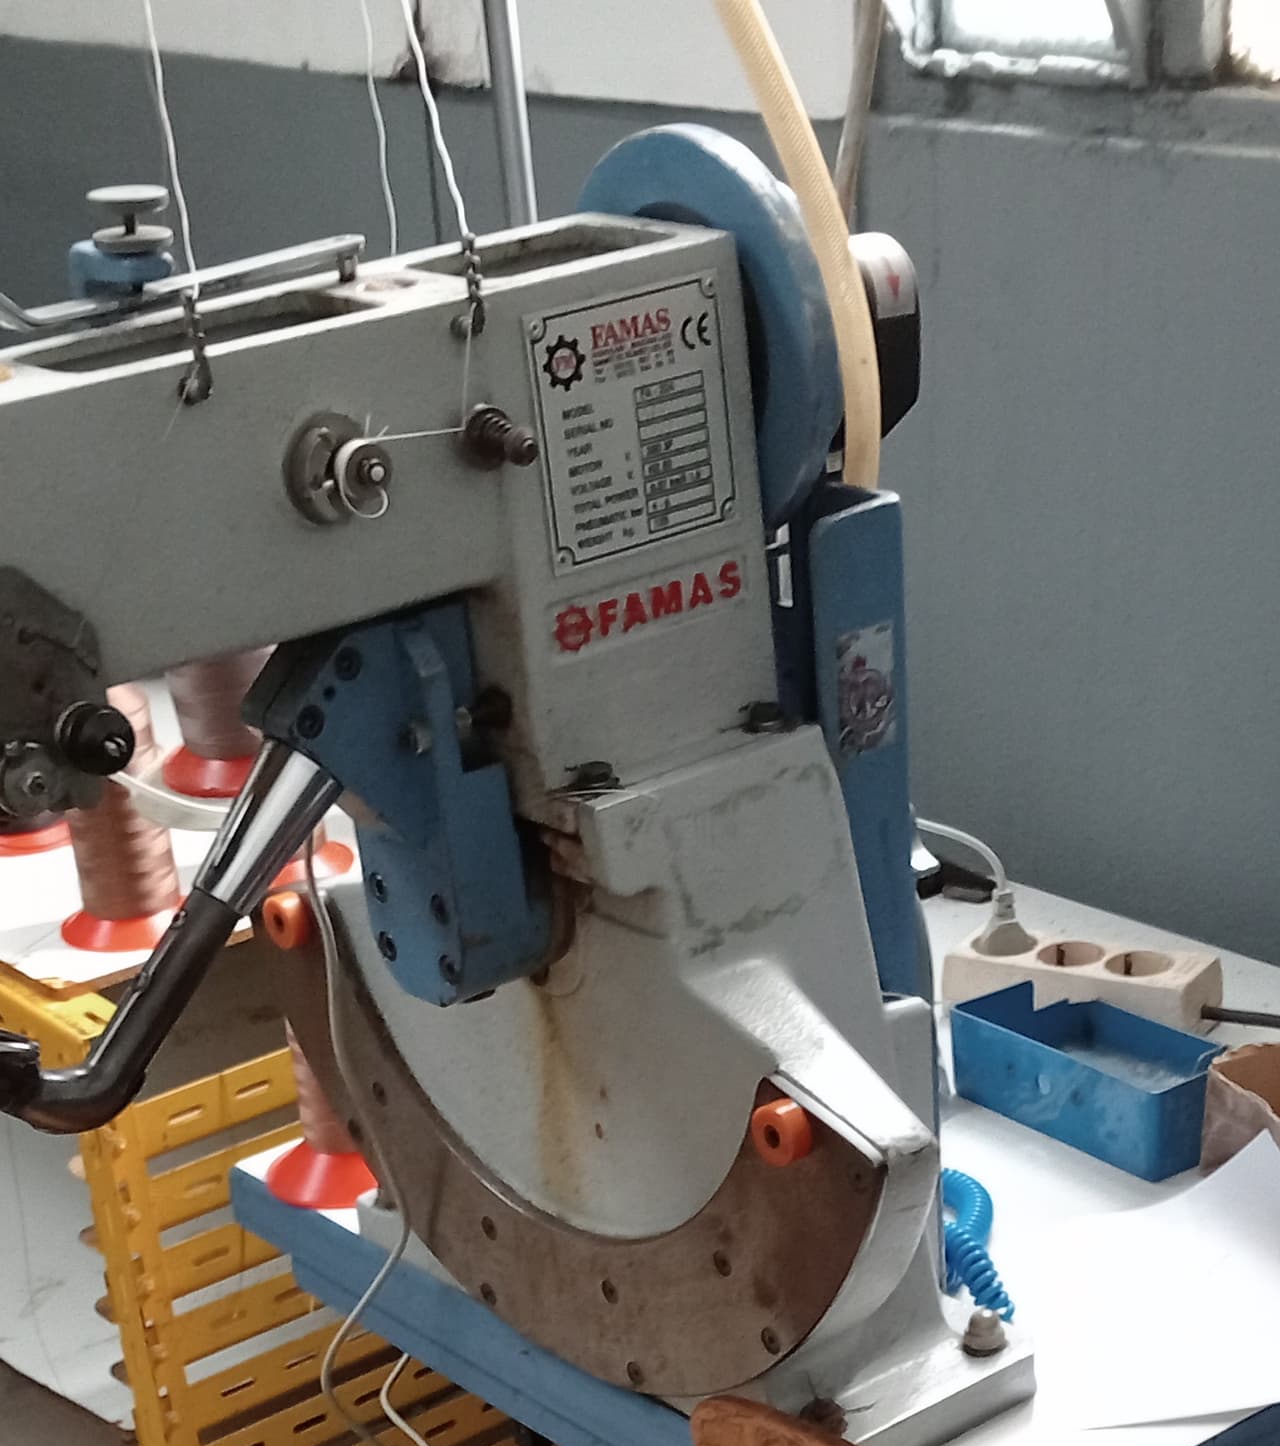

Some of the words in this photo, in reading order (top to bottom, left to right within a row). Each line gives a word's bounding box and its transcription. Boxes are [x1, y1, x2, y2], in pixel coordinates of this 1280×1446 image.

[591, 308, 671, 349] FAMAS
[680, 312, 711, 349] CE
[598, 560, 742, 637] FAMAS
